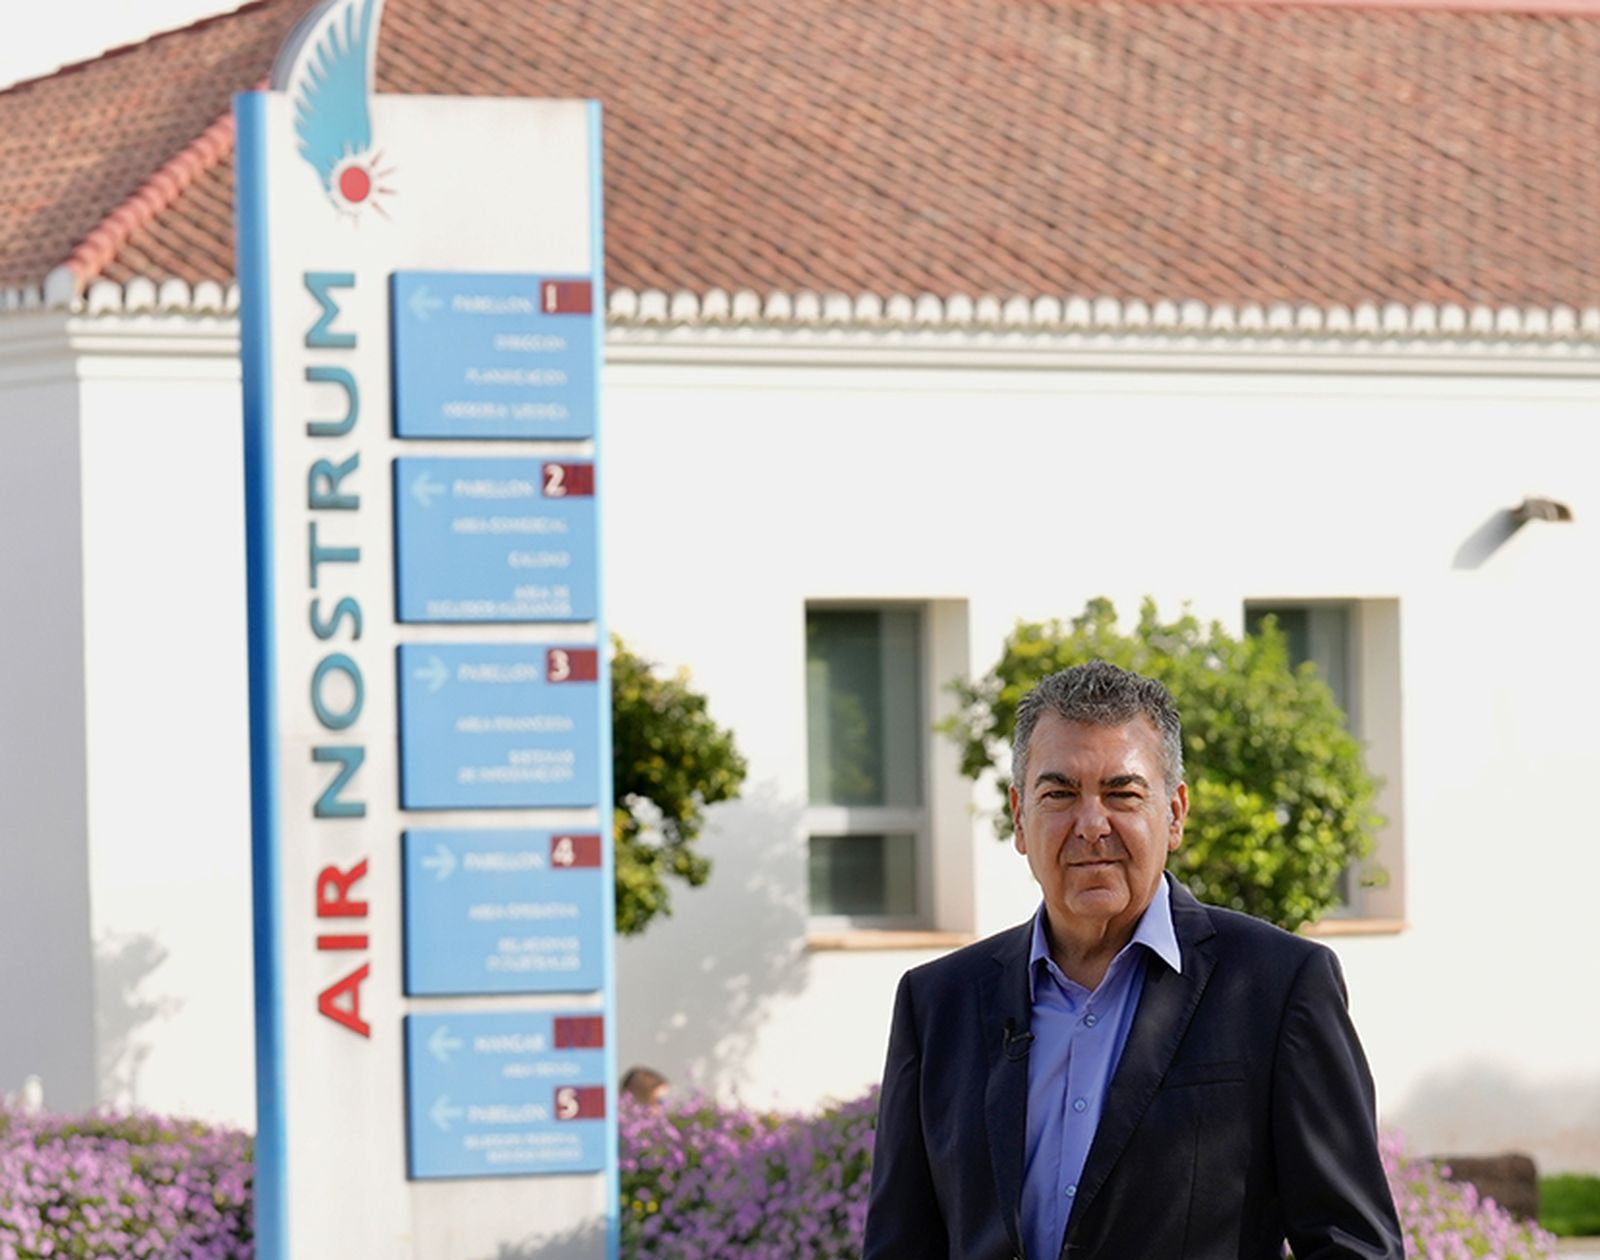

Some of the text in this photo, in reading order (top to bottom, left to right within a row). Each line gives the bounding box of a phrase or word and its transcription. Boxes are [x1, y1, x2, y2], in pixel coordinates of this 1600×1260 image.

[546, 284, 557, 312] 1
[544, 464, 567, 496] 2
[303, 271, 371, 1040] AIR NOSTRUM
[549, 650, 570, 681] 3
[553, 837, 576, 866] 4
[557, 1088, 579, 1119] 5
